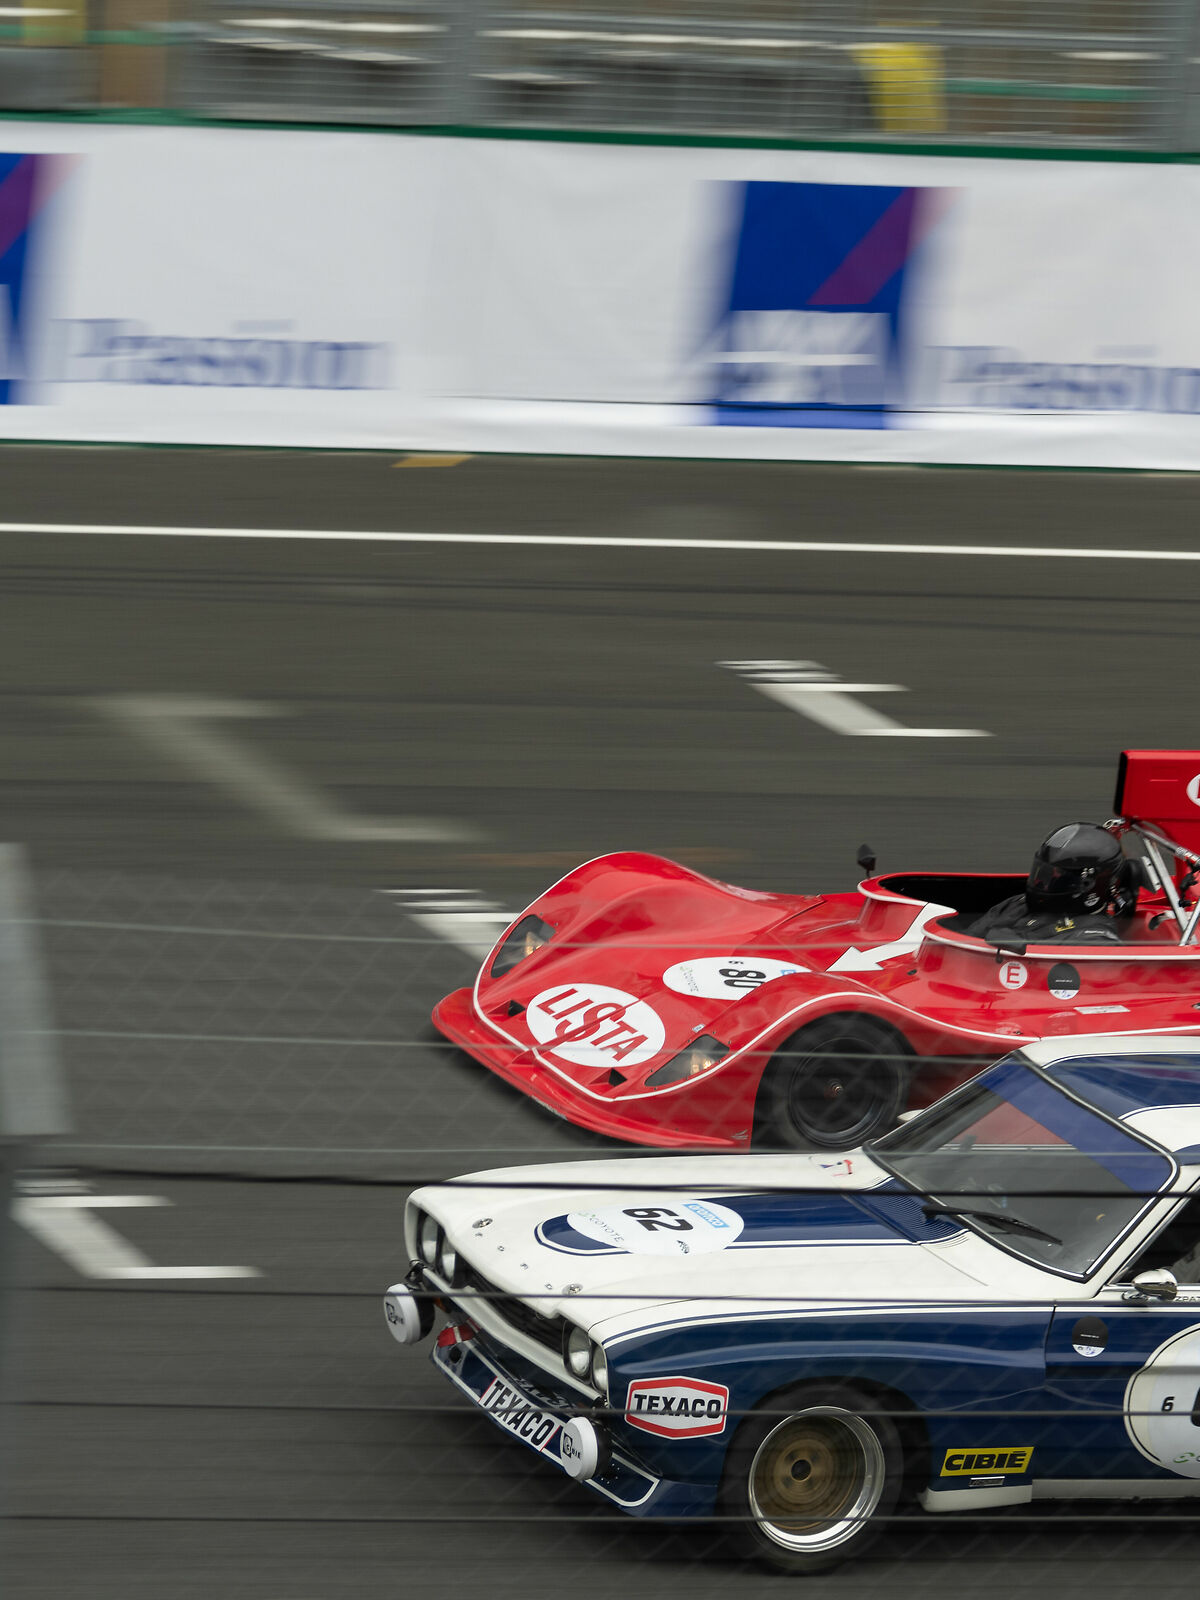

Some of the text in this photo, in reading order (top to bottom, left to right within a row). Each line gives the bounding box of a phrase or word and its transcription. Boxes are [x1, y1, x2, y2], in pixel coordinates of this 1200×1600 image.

[1006, 965, 1021, 984] E
[536, 988, 649, 1062] LISTA
[589, 1216, 625, 1243] COYOTE
[622, 1207, 694, 1232] 62
[483, 1380, 555, 1446] TEXACO
[634, 1394, 721, 1419] TEXACO
[1161, 1396, 1175, 1412] 6
